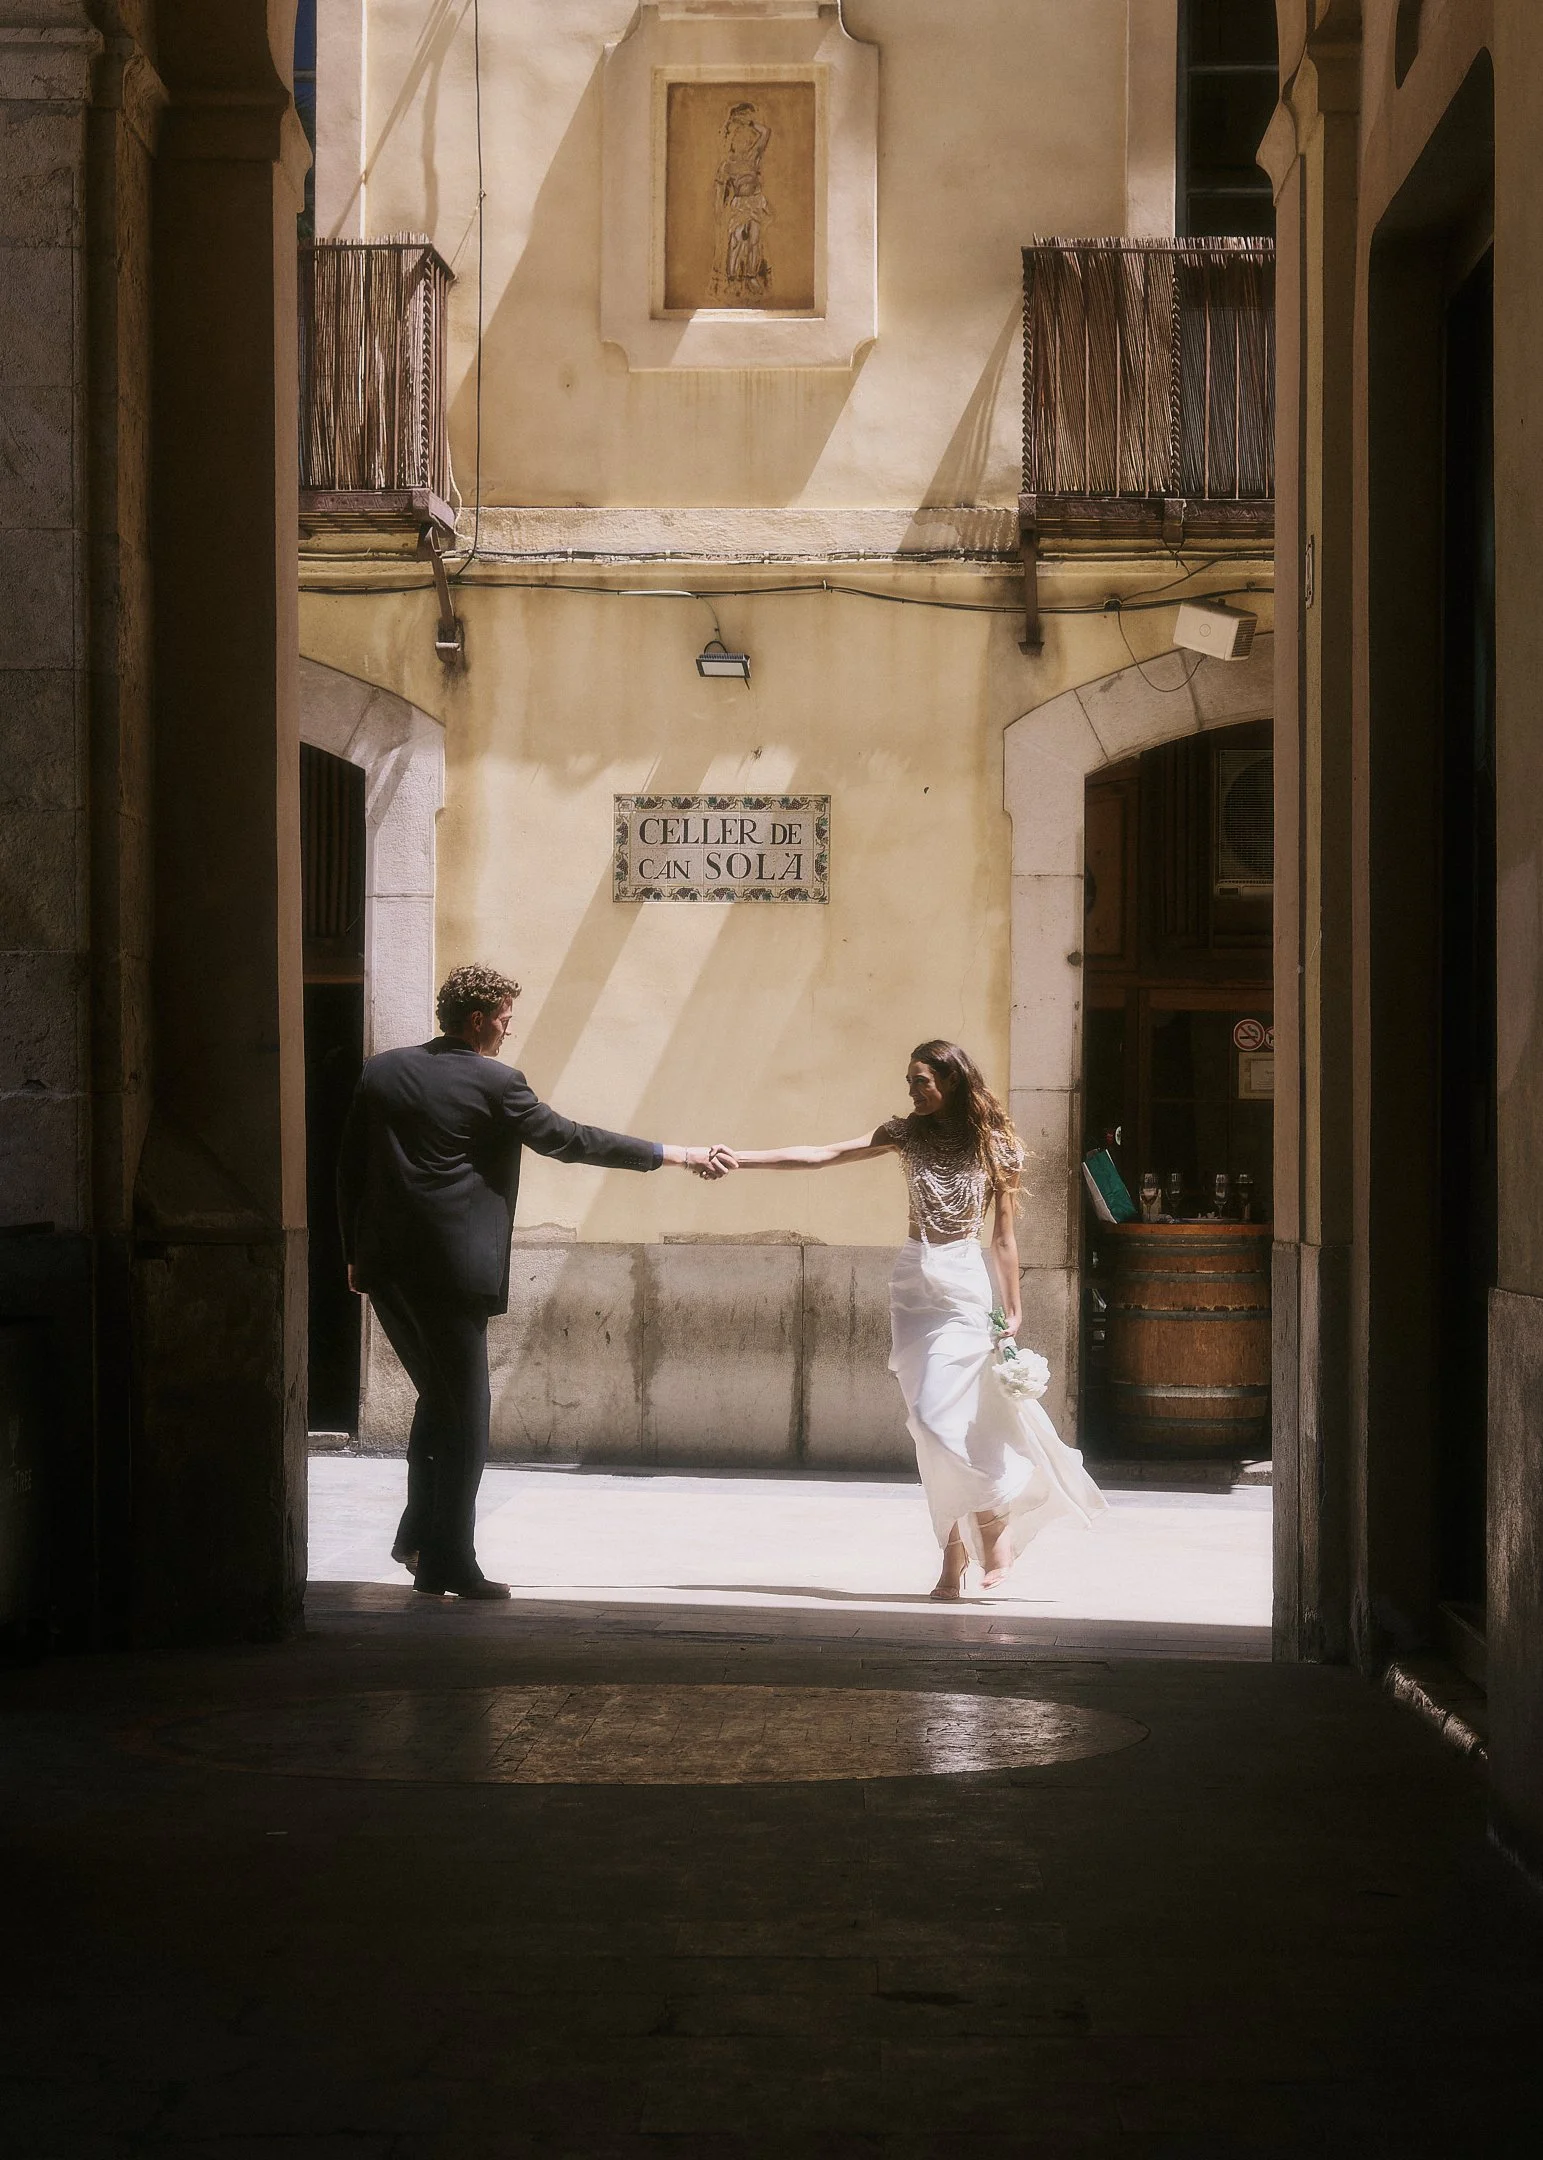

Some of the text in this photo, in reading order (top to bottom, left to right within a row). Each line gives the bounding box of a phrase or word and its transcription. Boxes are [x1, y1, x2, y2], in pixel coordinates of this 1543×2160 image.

[639, 818, 802, 845] CELLER DE
[638, 858, 692, 880] CAN
